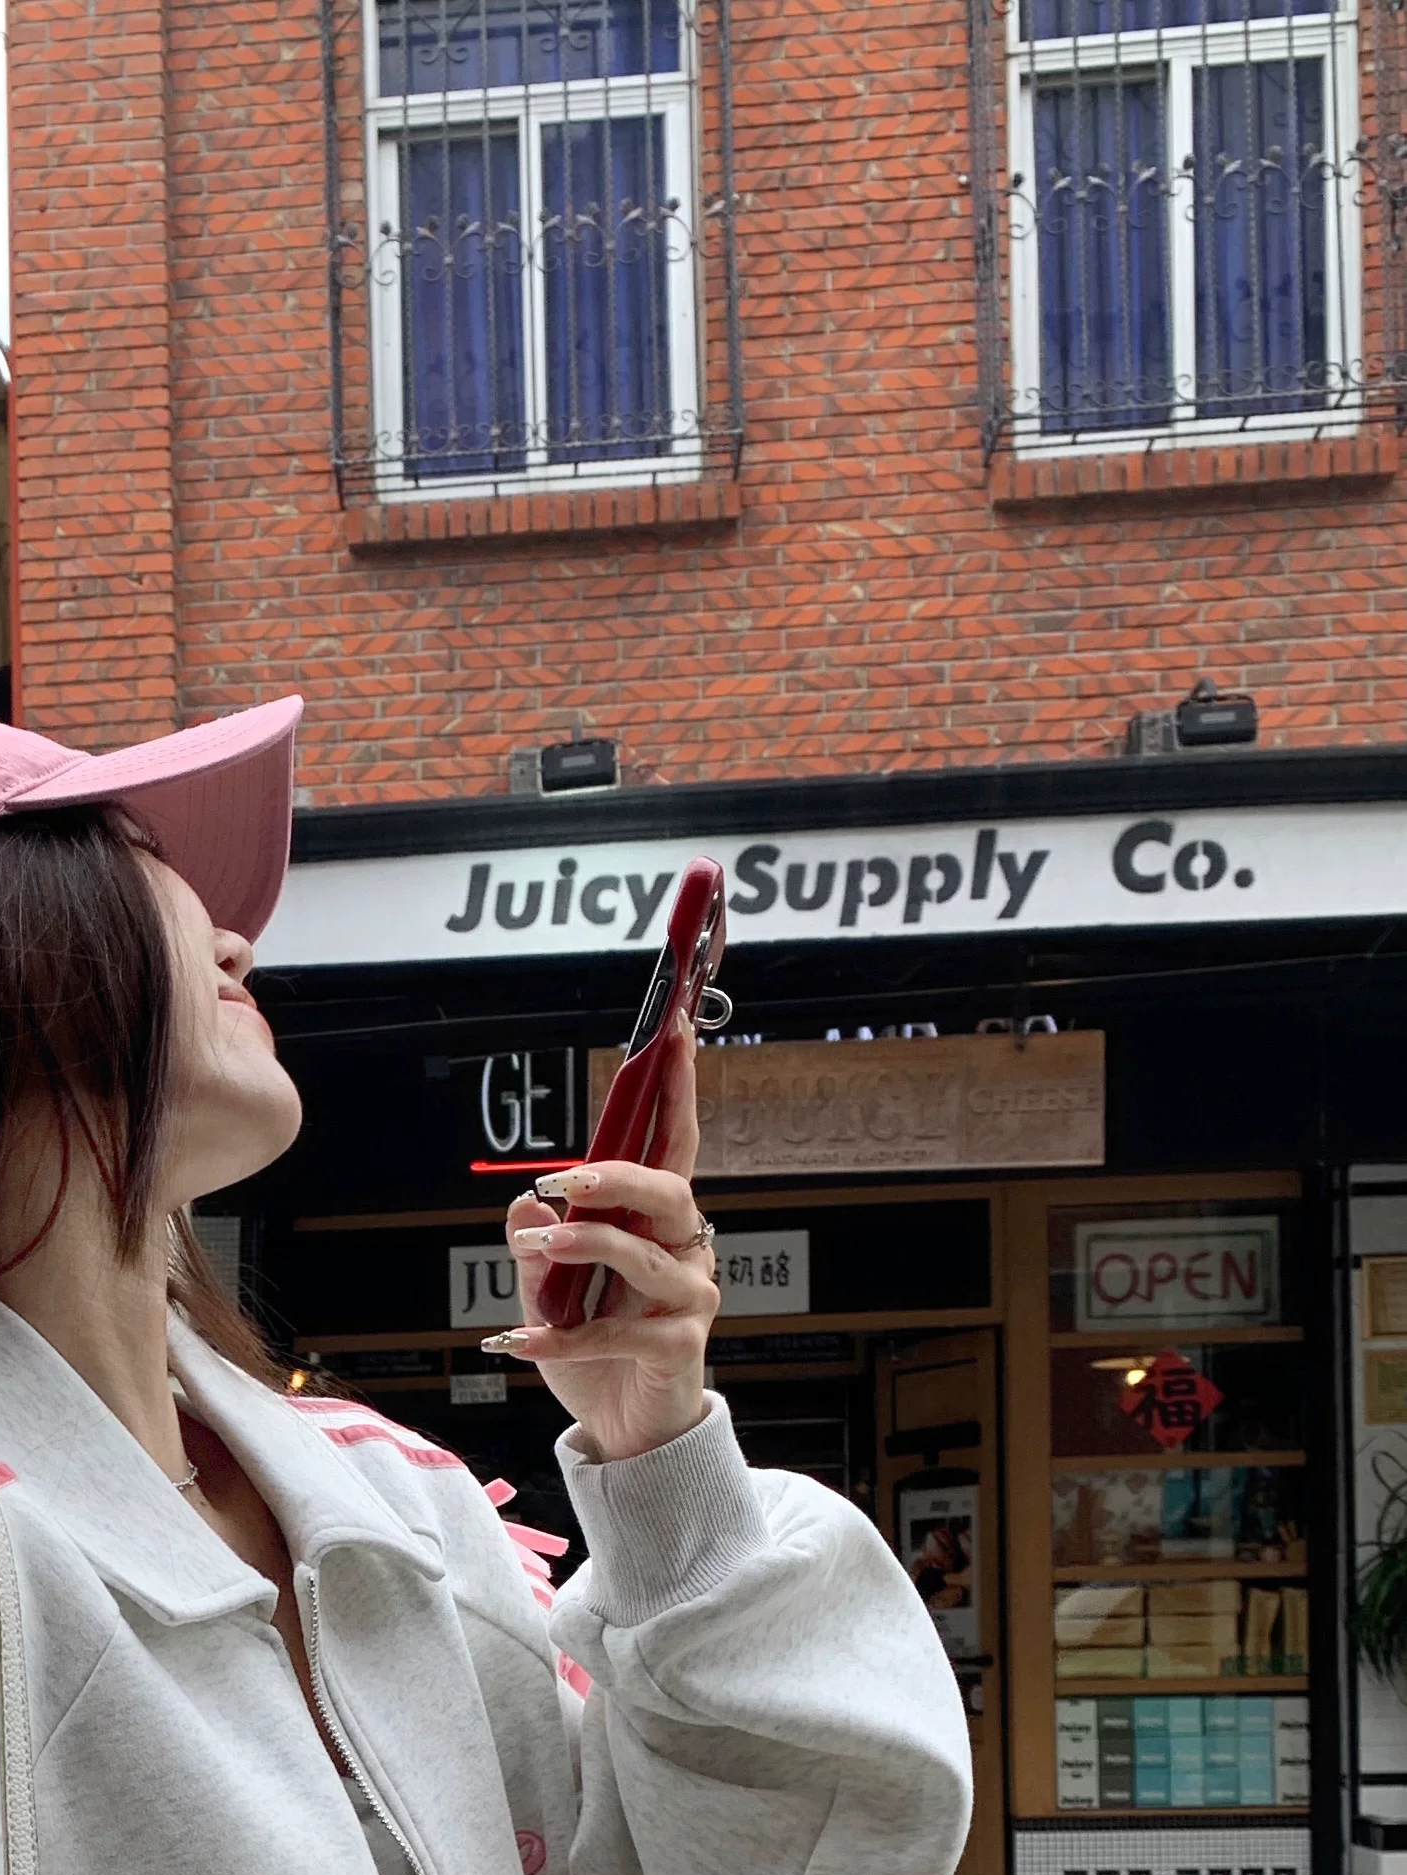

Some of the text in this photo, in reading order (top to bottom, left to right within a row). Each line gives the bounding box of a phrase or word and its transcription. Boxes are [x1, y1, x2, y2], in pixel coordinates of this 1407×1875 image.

[445, 819, 1255, 941] Juicy Supply Co.
[1094, 1250, 1258, 1305] OPEN
[1132, 1366, 1203, 1431] 福
